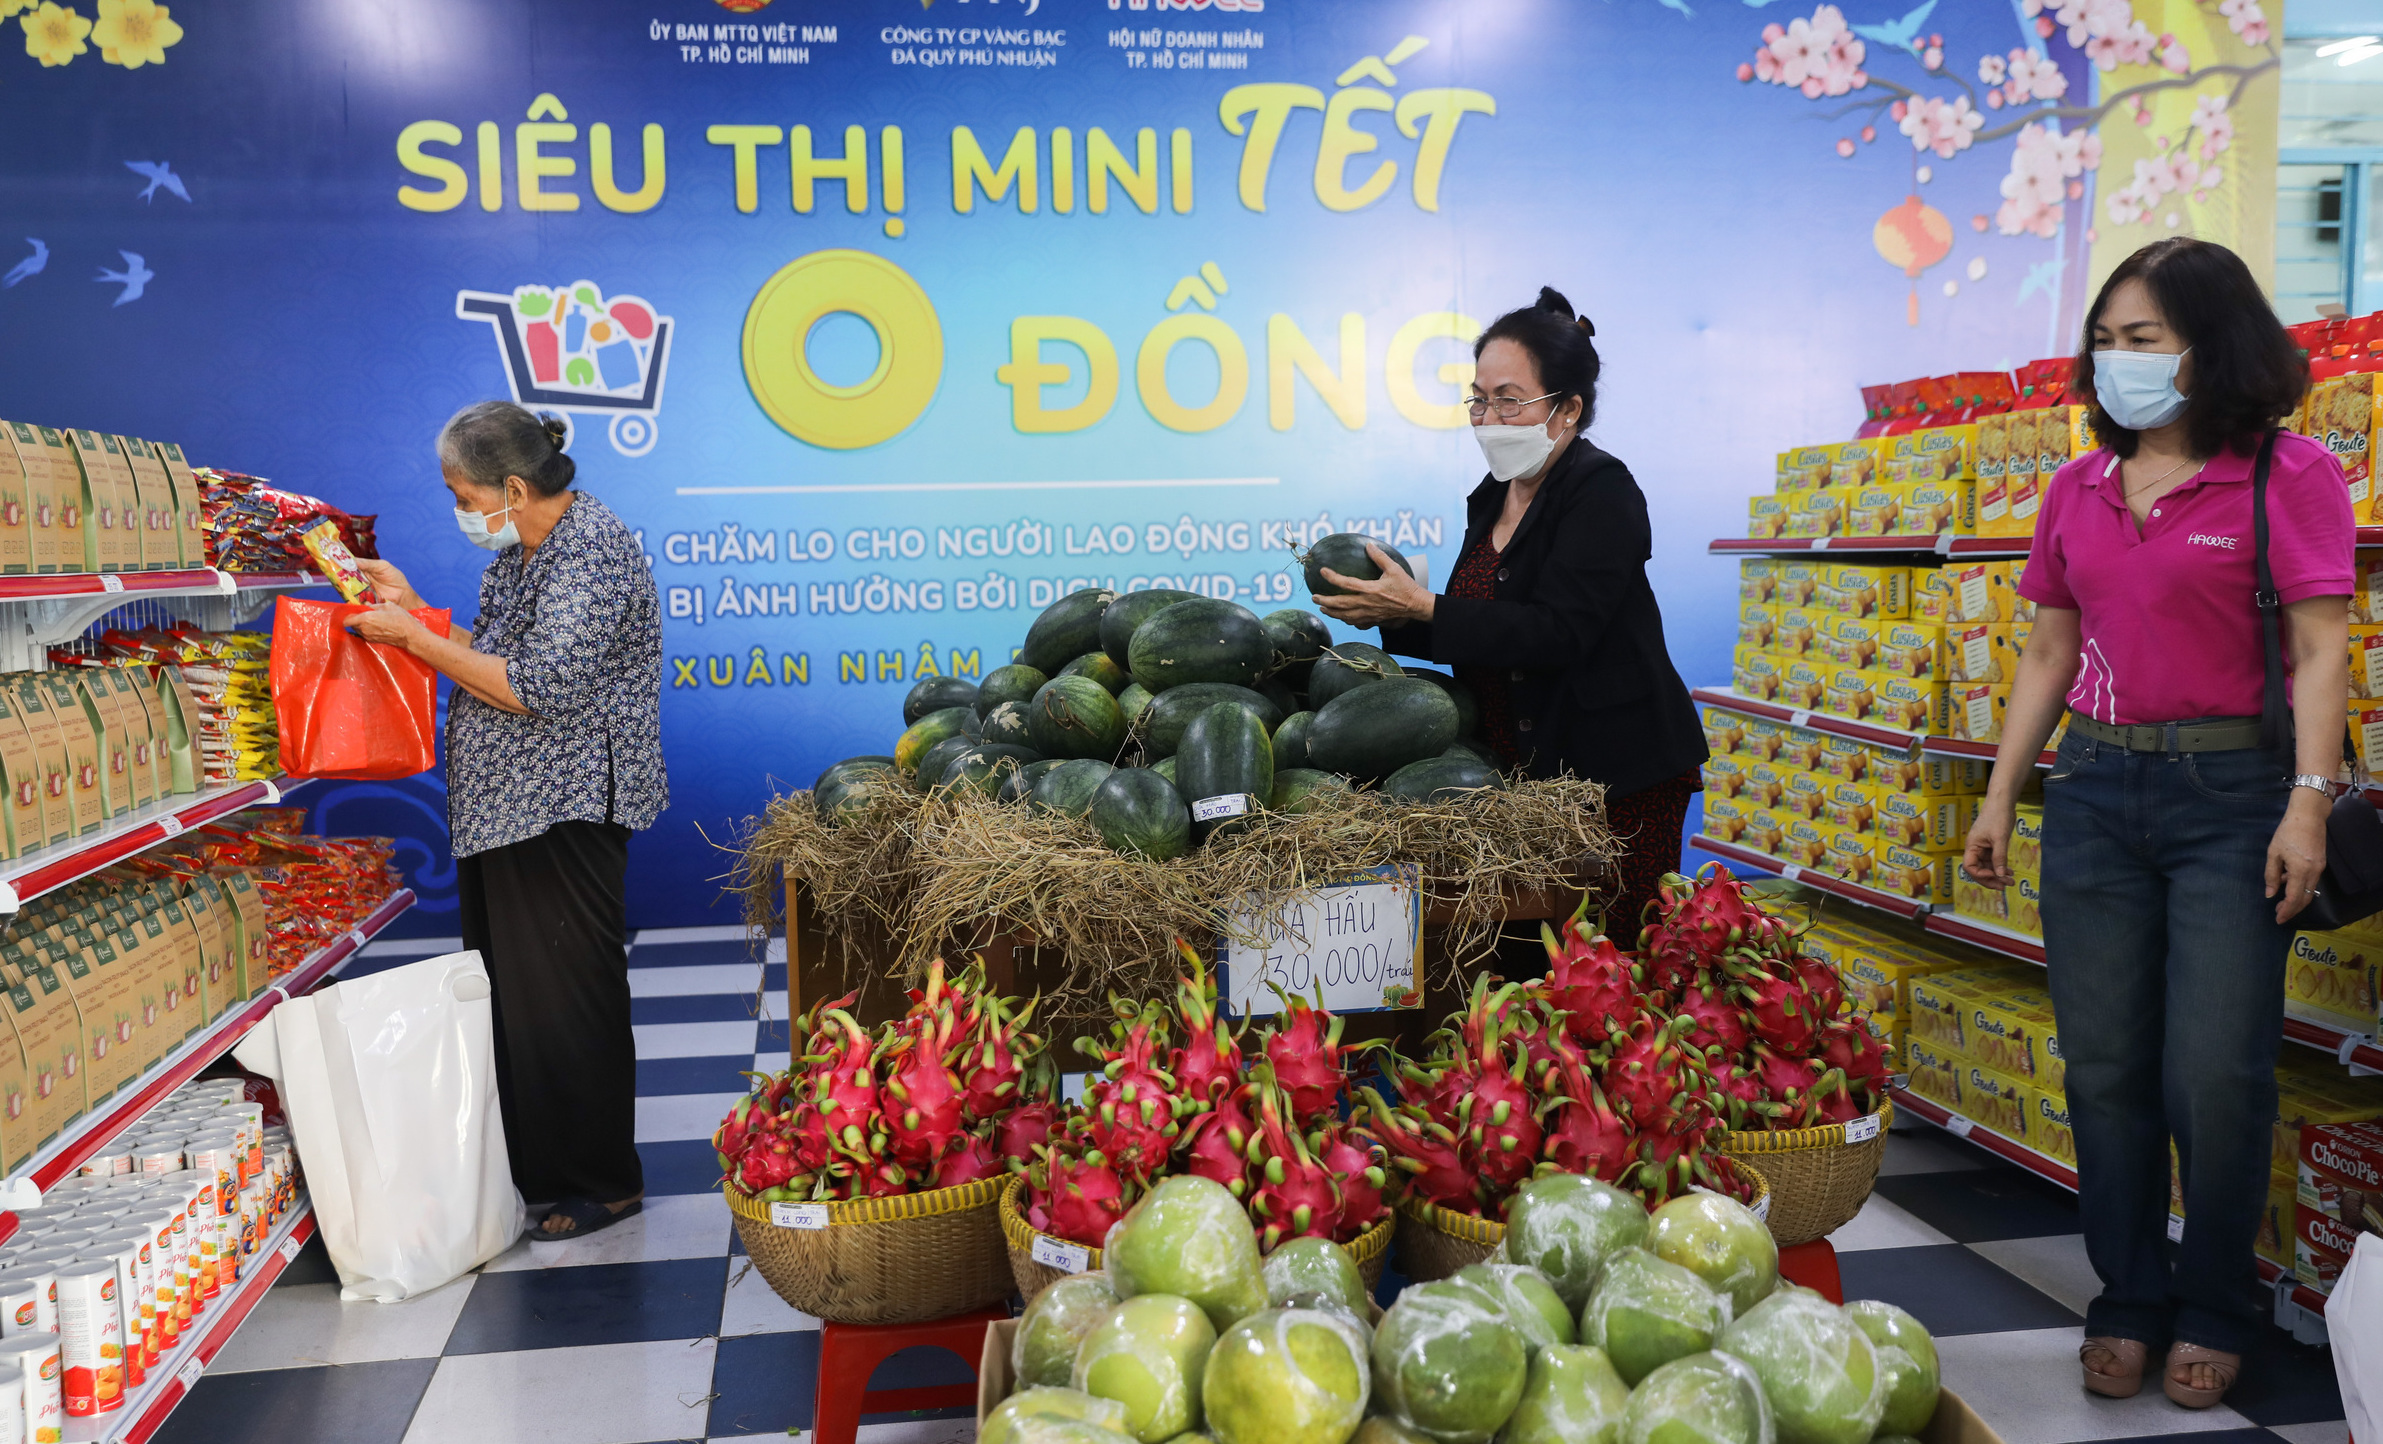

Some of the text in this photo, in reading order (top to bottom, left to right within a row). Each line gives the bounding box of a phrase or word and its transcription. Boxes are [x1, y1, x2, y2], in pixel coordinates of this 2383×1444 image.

[650, 18, 838, 45] ỦY BAN MTTQ VIỆT NAM
[881, 24, 1066, 49] CÔNG TY CP VÀNG BẠC
[1108, 27, 1264, 49] HỘI NỮ DOANH NHÂN
[681, 42, 810, 64] TP. HỒ CHÍ MINH
[891, 46, 1056, 69] ĐÁ QUÝ PHÚ NHUẬN
[1126, 48, 1248, 69] TP. HỒ CHÍ MINH
[397, 35, 1497, 238] SIÊU THỊ MINI TẾT
[997, 261, 1477, 434] ĐỒNG
[665, 524, 776, 563] CHĂM
[788, 530, 835, 561] LO
[846, 529, 926, 559] CHO
[937, 519, 1053, 557] NGƯỜI
[1065, 525, 1135, 555] LAO
[1145, 516, 1250, 559] ĐỘNG
[1261, 513, 1334, 550] KHÓ
[2187, 531, 2238, 550] HAWEE
[669, 587, 703, 625] BỊ
[715, 578, 797, 617] ẢNH
[809, 574, 943, 613] HƯỞNG
[956, 573, 1016, 610] BỞI
[673, 641, 979, 687] XUÂN NHÂM
[1202, 806, 1231, 817] 30.000
